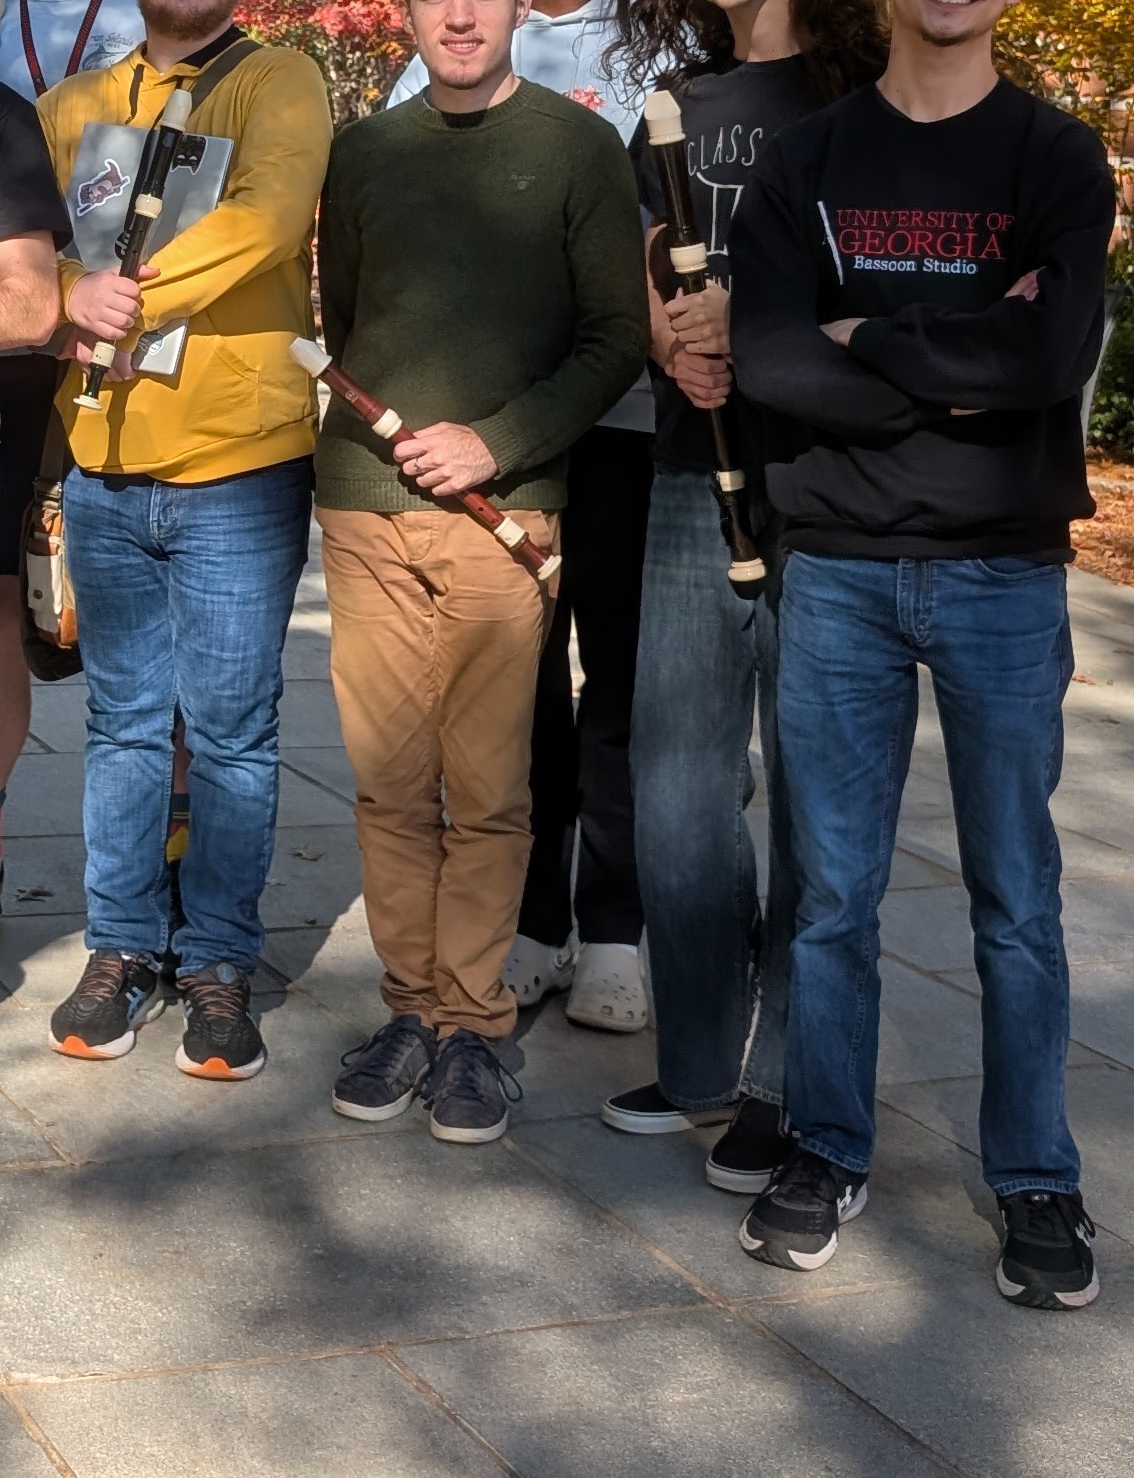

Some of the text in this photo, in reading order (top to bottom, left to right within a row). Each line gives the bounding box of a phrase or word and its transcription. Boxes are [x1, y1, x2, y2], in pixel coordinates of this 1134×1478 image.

[687, 124, 763, 177] CLASS
[836, 209, 1015, 232] UNIVERSITY OF
[838, 228, 1007, 260] GEORGIA
[852, 255, 978, 275] Bassoon Studio
